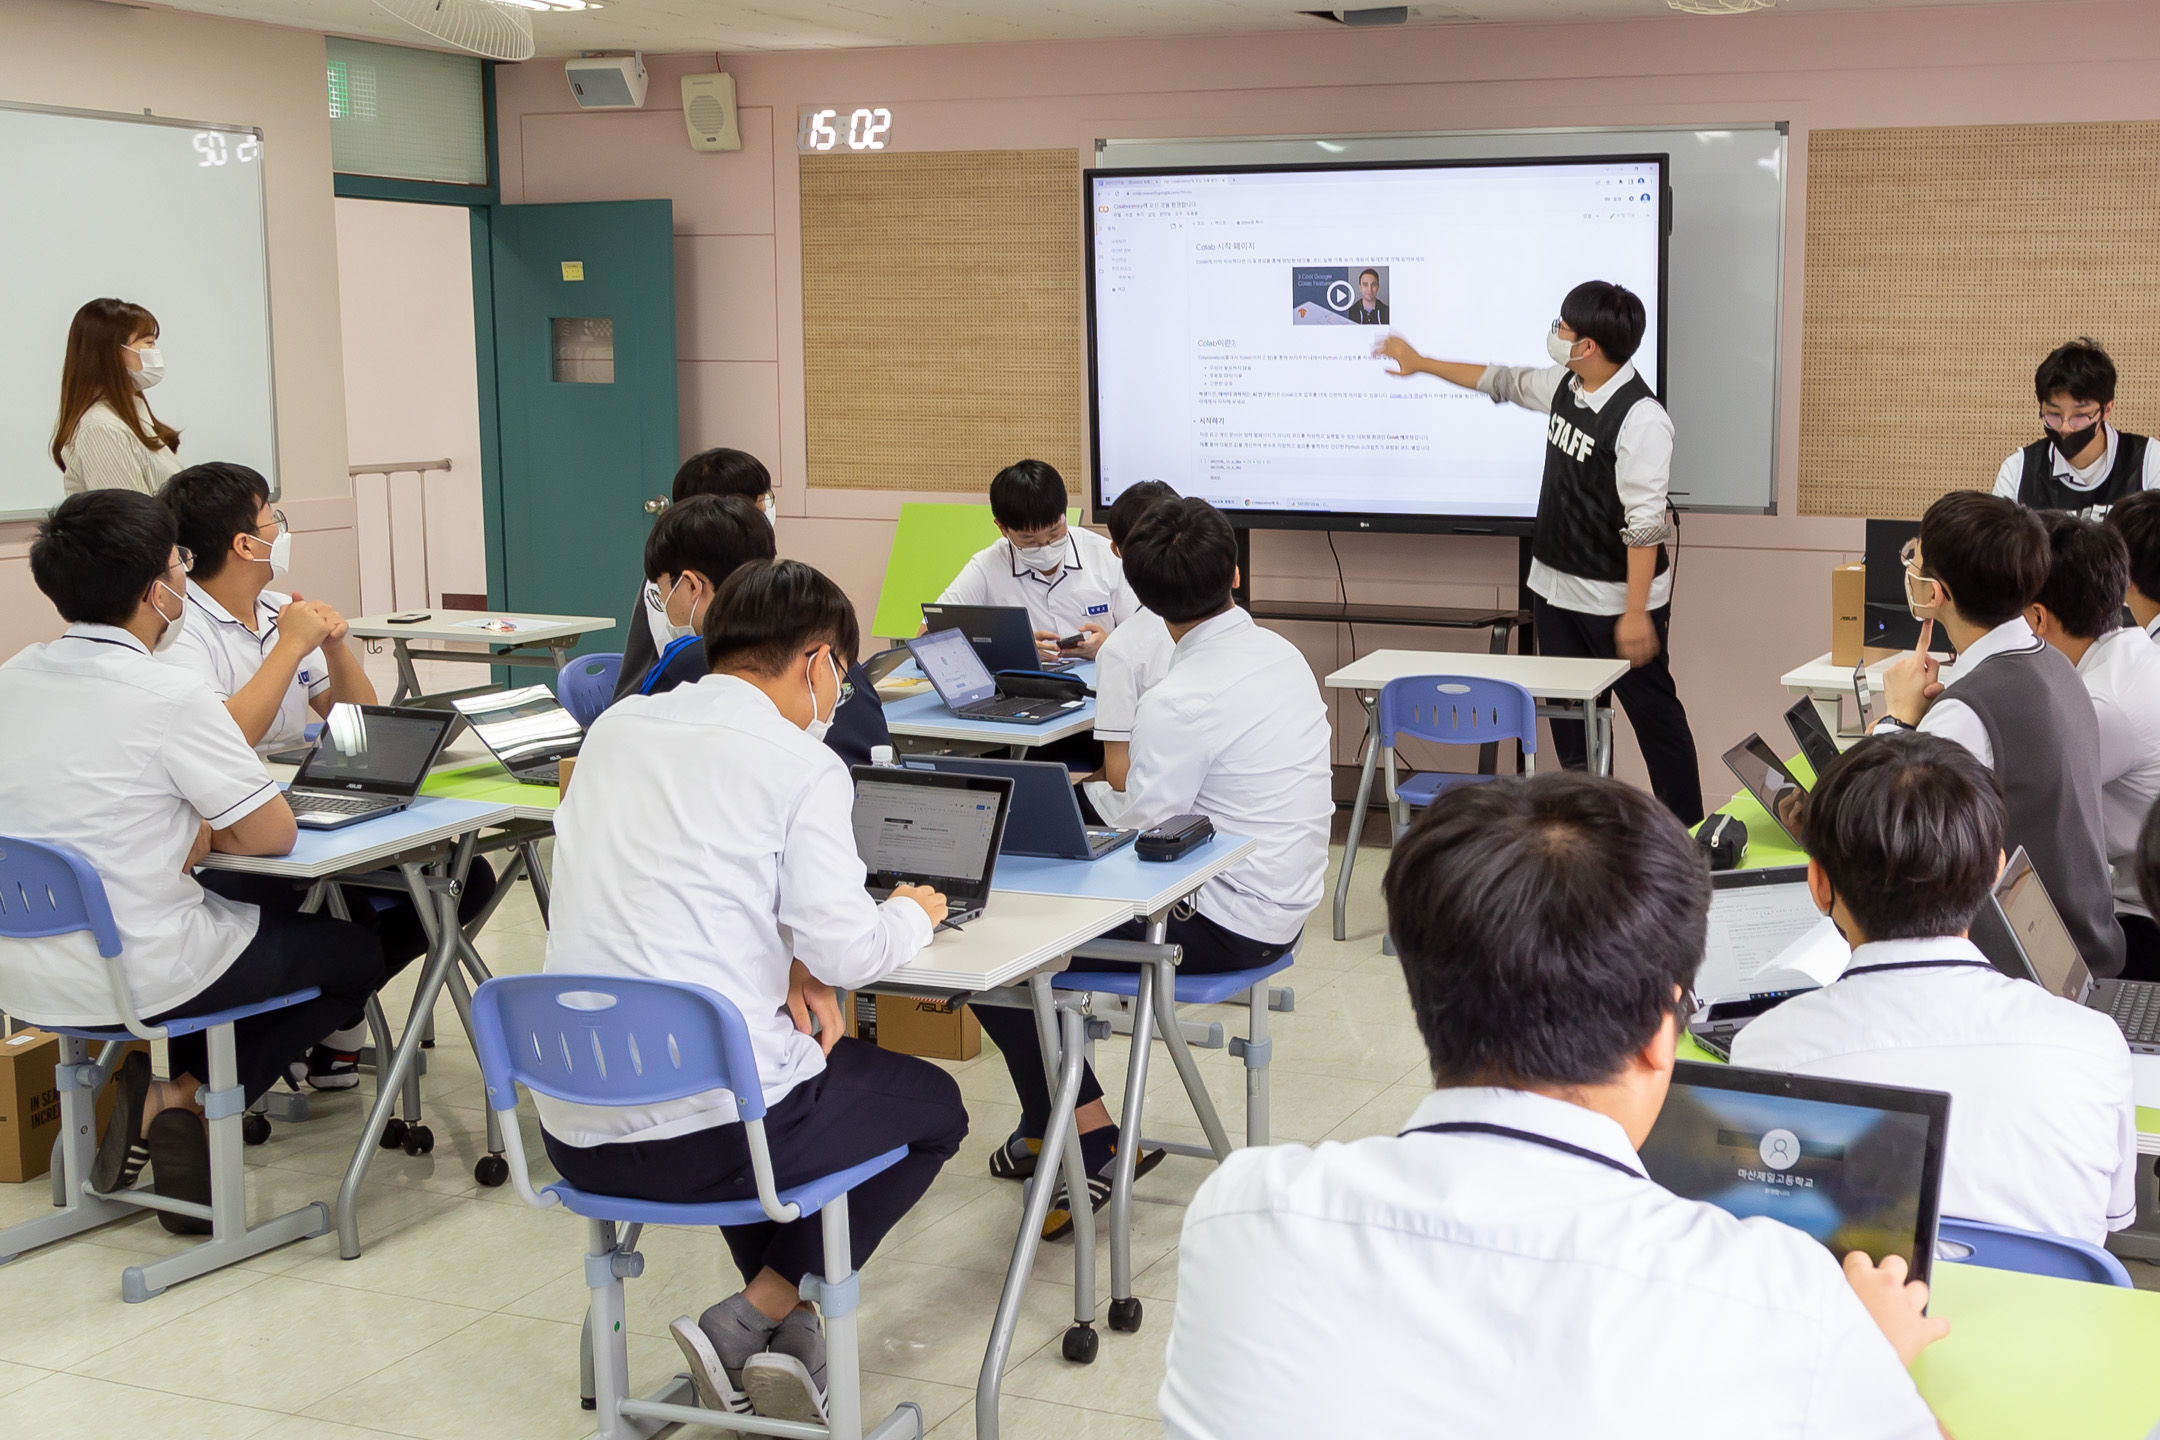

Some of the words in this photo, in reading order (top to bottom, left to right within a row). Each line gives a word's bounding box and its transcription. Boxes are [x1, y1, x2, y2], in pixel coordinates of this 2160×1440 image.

[1196, 243, 1216, 252] Colab
[1218, 242, 1232, 251] 시작
[1233, 242, 1255, 251] 페이지
[1314, 273, 1332, 281] Google
[1197, 339, 1236, 349] Colab이란?
[1199, 416, 1225, 426] 시작하기
[1548, 413, 1595, 463] STAFF
[915, 1002, 953, 1014] ASUS
[30, 1095, 40, 1112] IN
[1738, 1168, 1814, 1188] 마산제일고등학교
